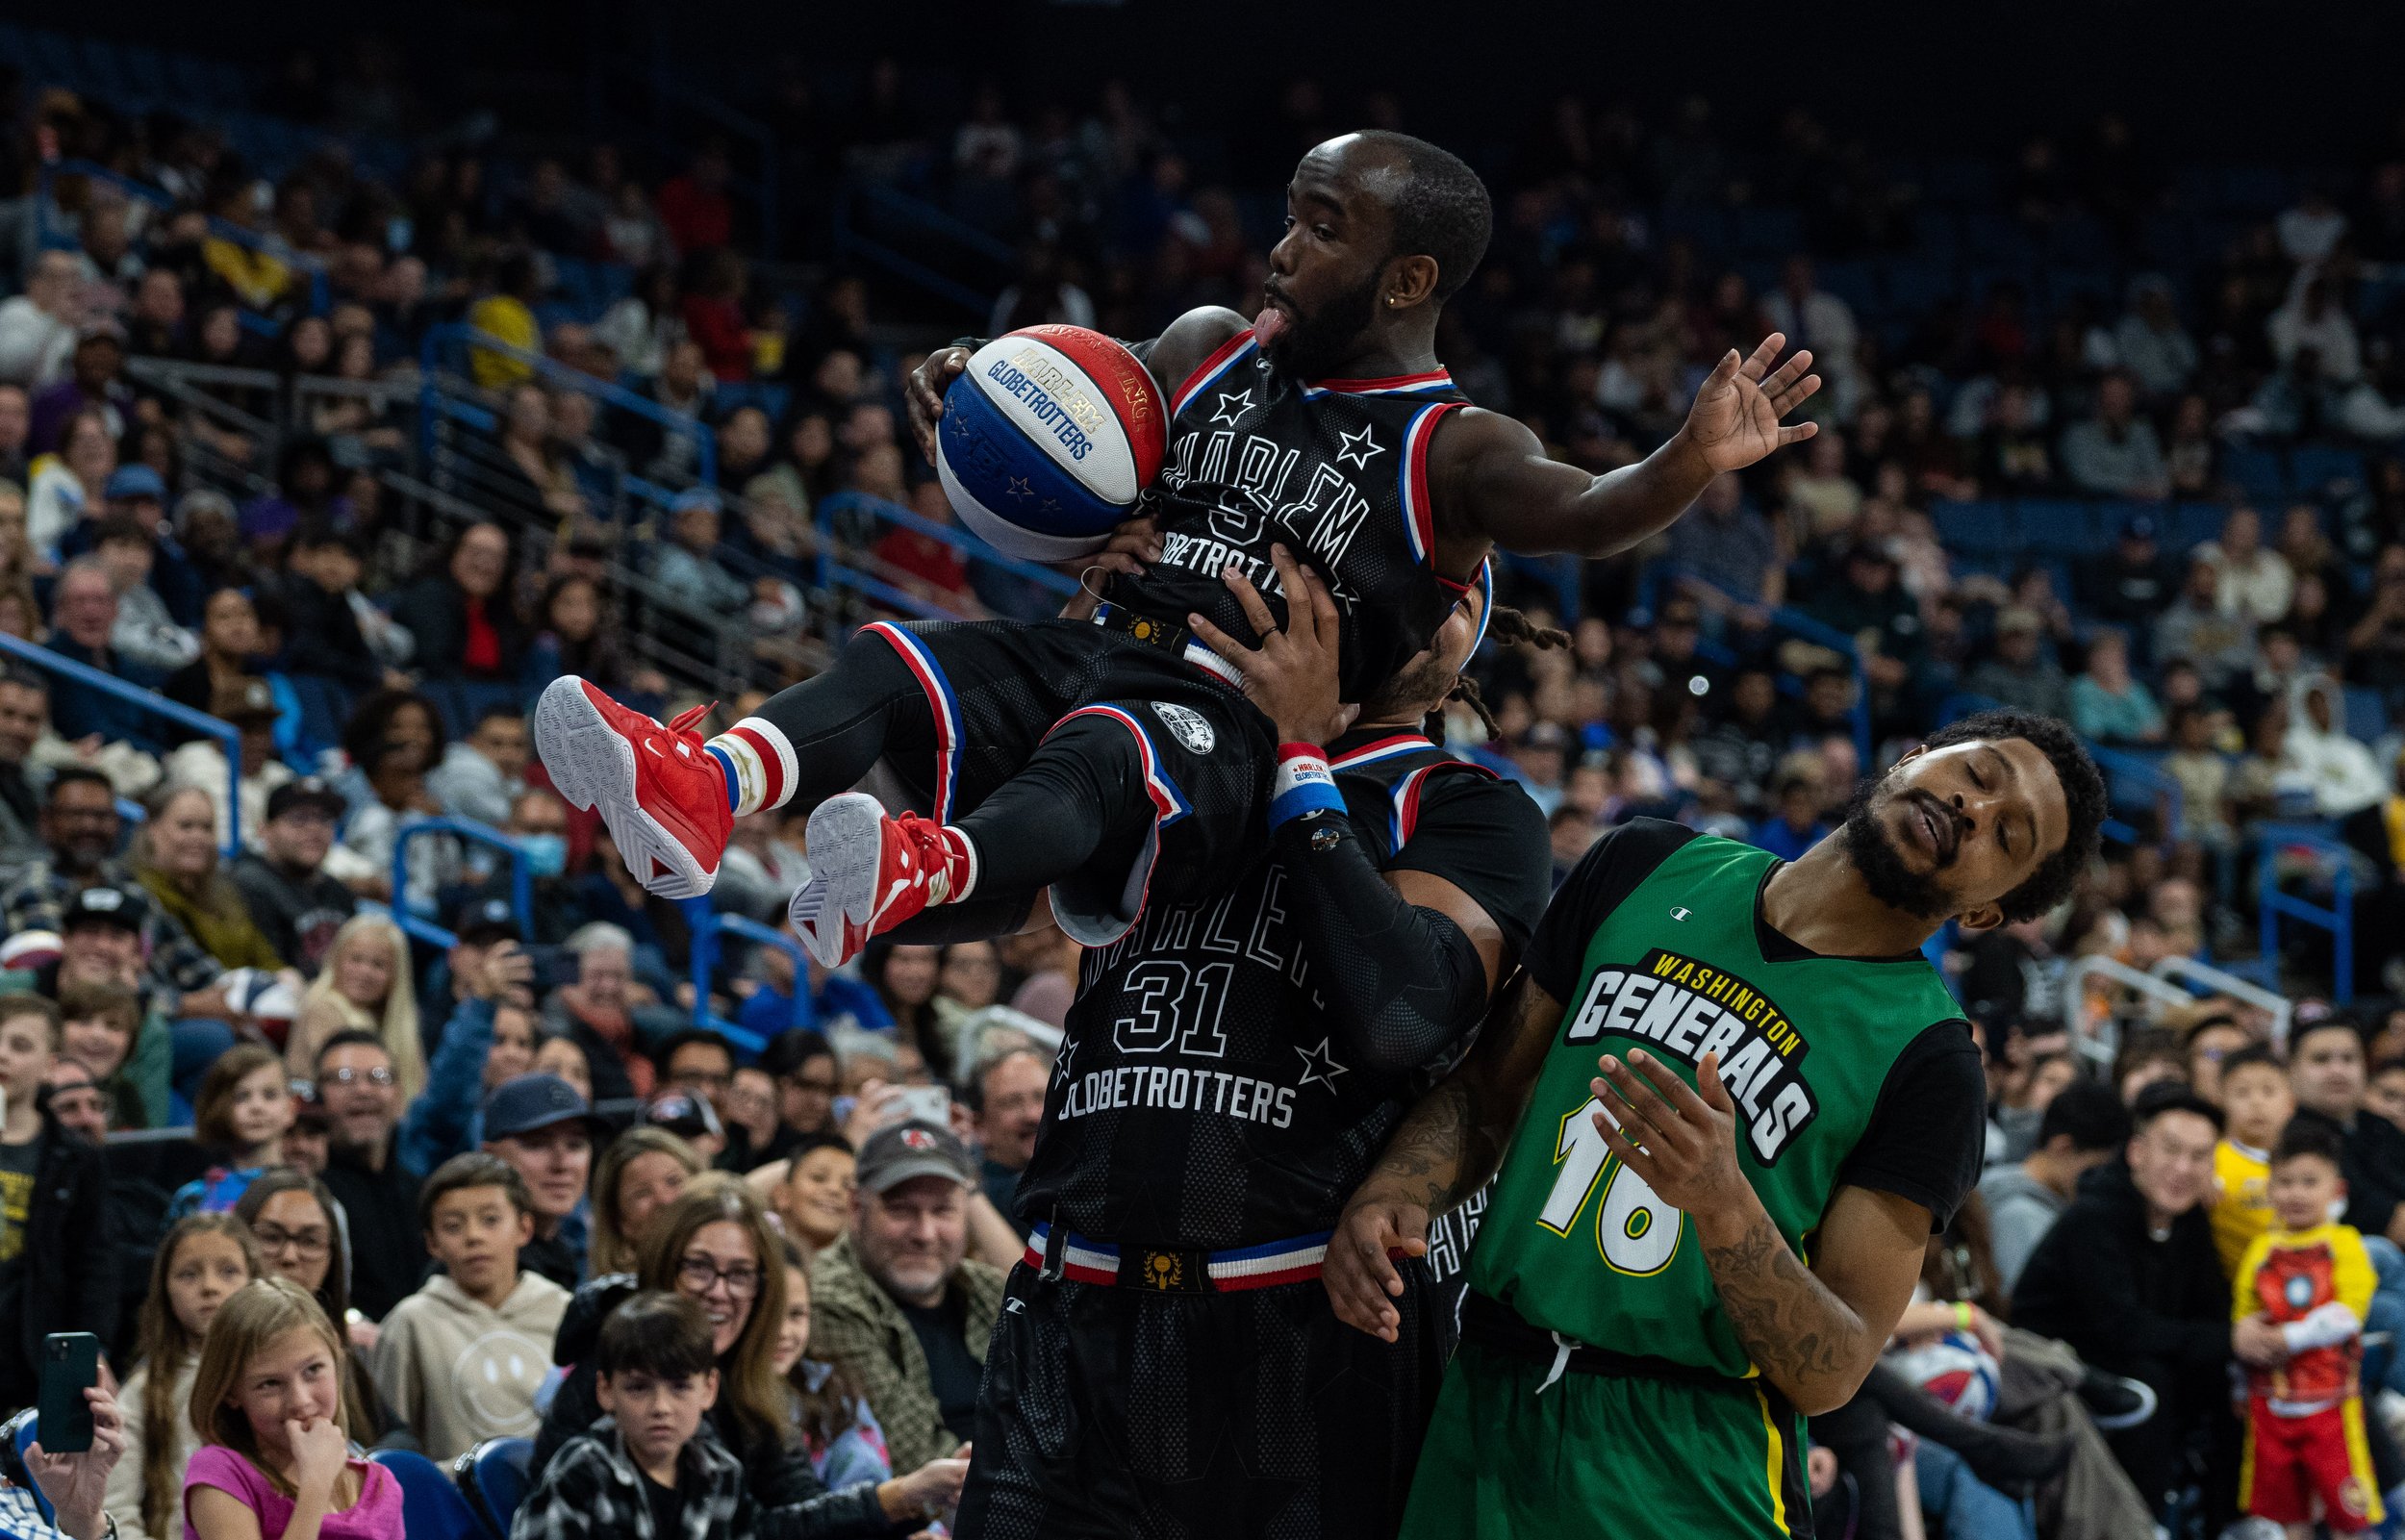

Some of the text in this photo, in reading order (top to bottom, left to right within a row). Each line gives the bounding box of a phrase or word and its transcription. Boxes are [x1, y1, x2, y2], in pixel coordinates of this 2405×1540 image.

[987, 360, 1094, 463] GLOBETROTTERS
[1012, 346, 1105, 435] HARLEM
[1113, 960, 1234, 1058] 31
[1652, 953, 1802, 1058] WASHINGTON
[1569, 971, 1810, 1160] GENERALS
